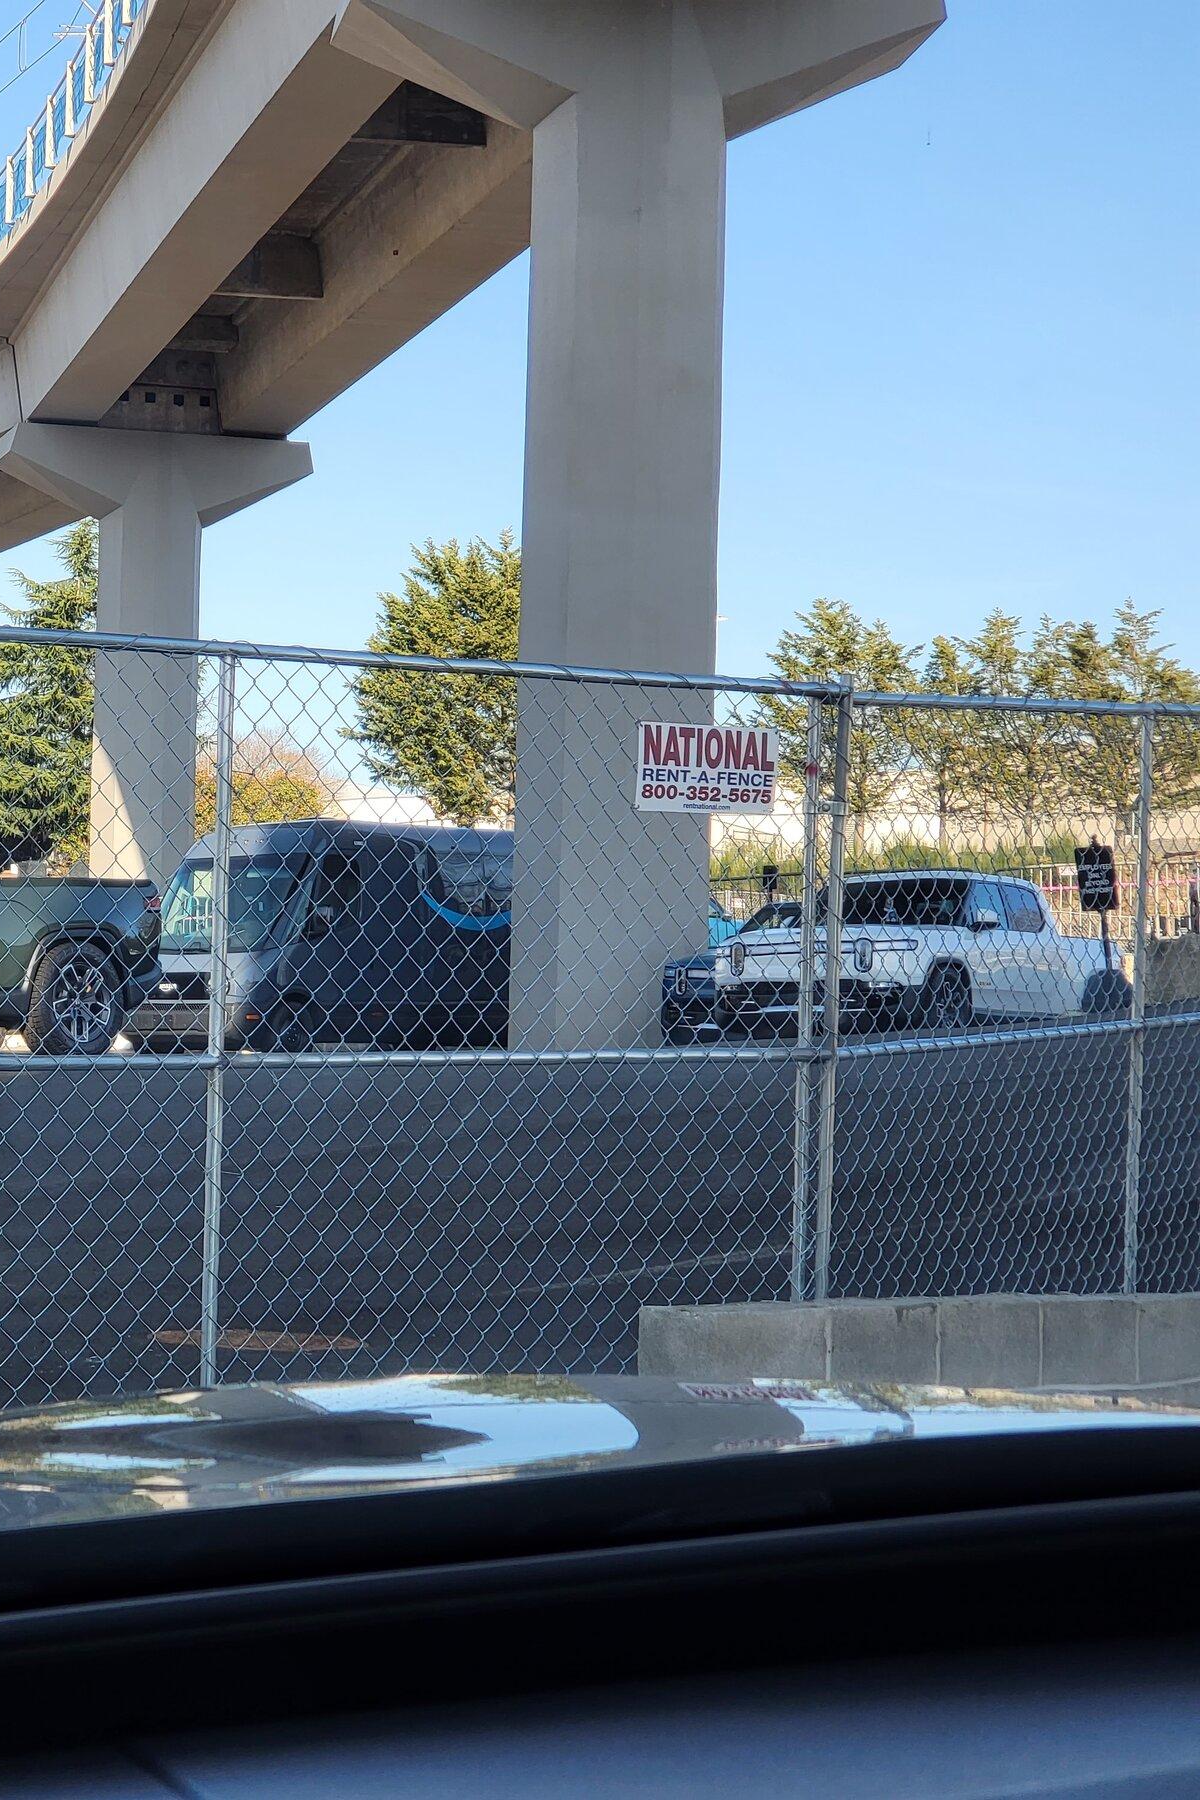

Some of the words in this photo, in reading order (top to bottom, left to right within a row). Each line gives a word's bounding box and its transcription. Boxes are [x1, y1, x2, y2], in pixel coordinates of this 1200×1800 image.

[643, 724, 775, 772] NATIONAL
[642, 767, 773, 788] RENT-A-FENCE
[641, 783, 772, 804] 800-352-5675
[682, 803, 731, 811] rentnational.com
